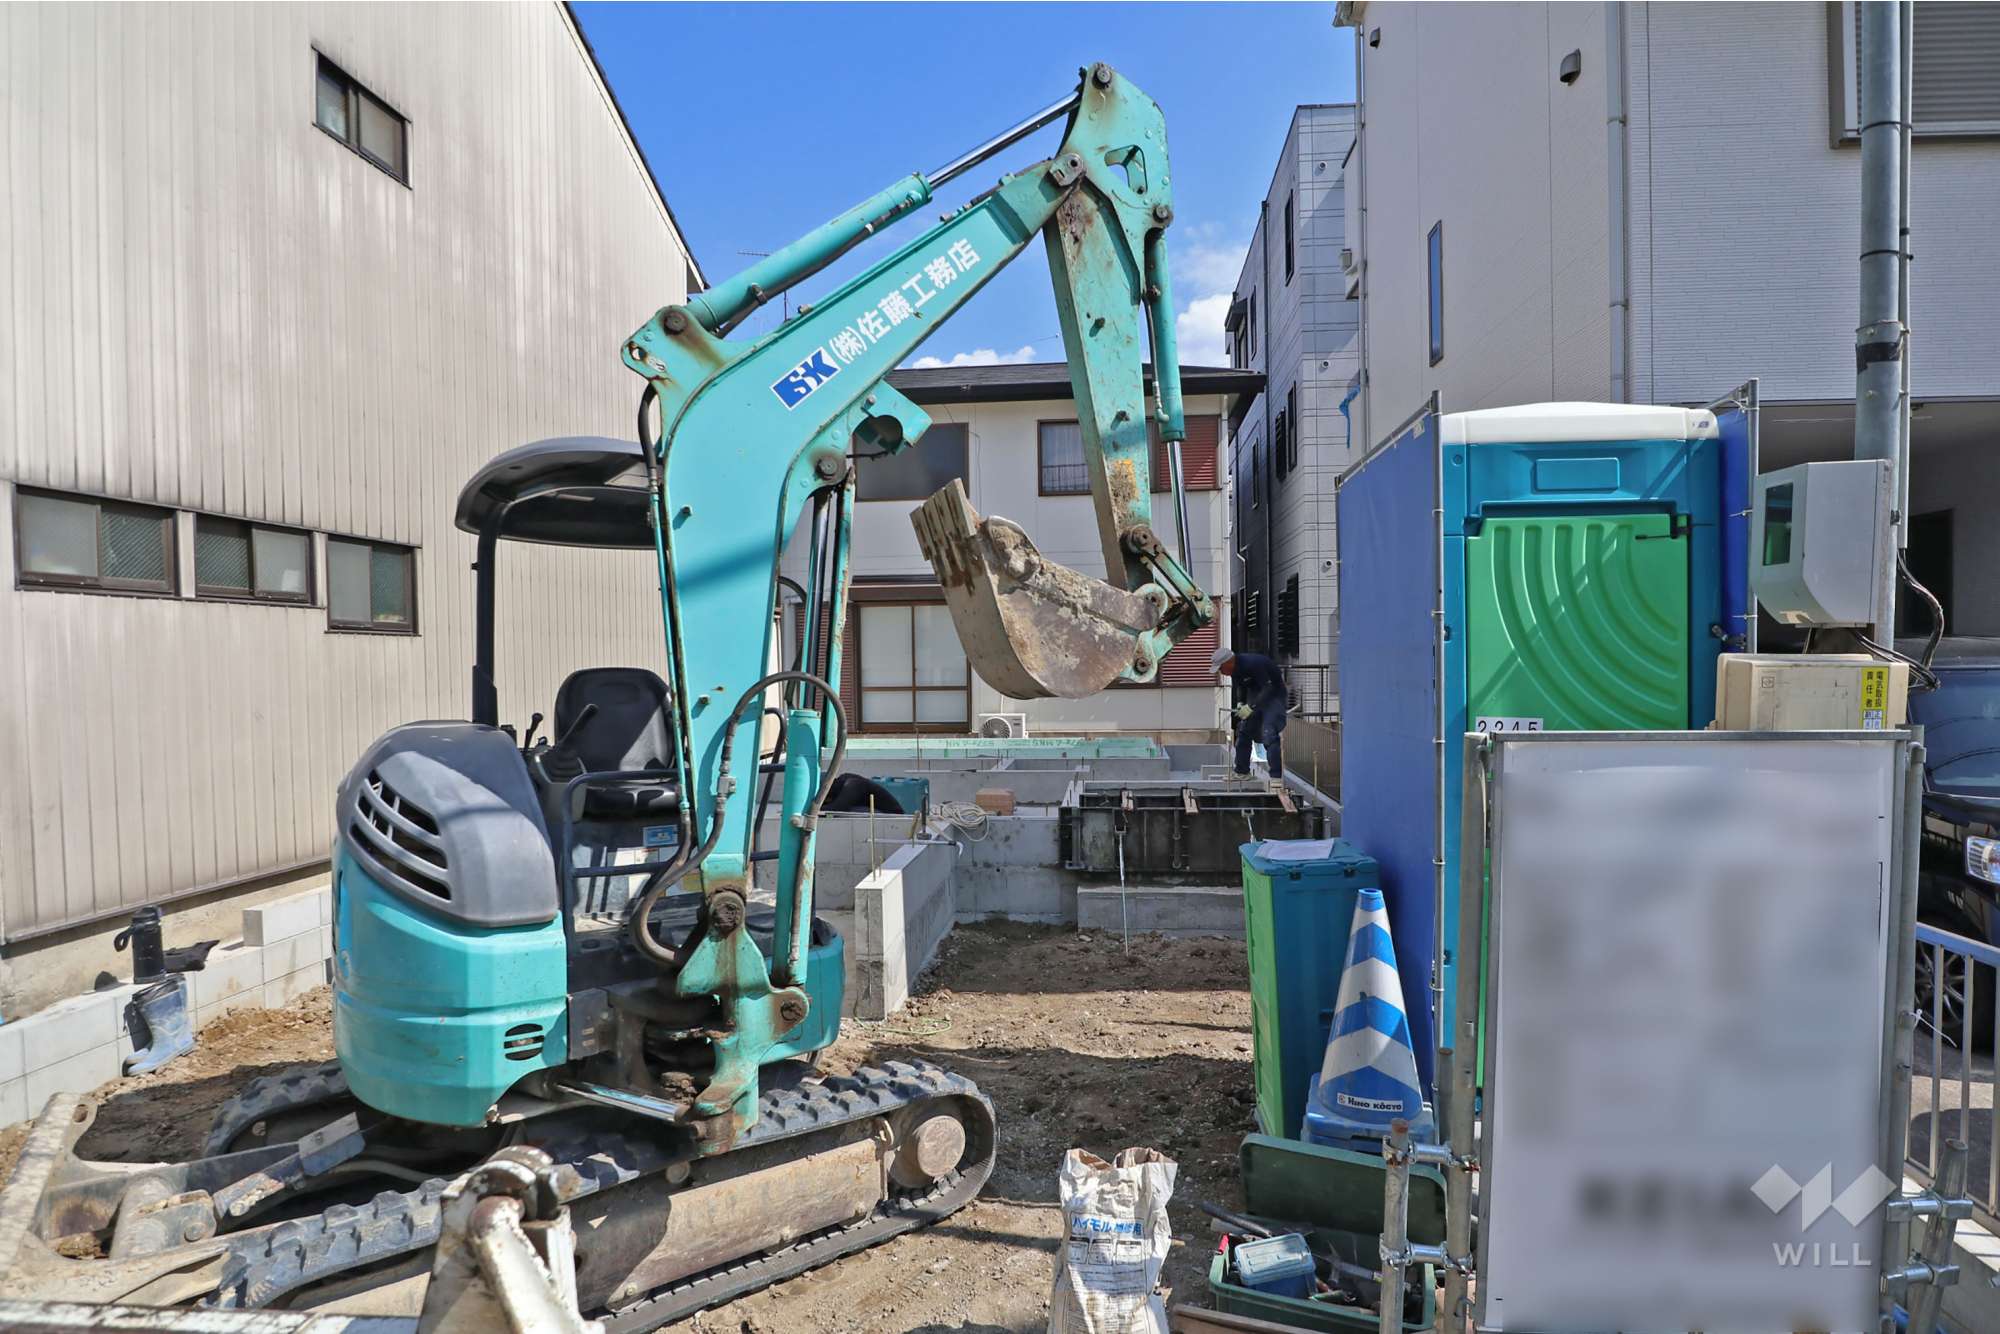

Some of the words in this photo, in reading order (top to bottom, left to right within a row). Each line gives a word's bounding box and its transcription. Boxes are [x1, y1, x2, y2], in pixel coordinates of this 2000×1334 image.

[829, 238, 981, 365] (株)佐藤工務店
